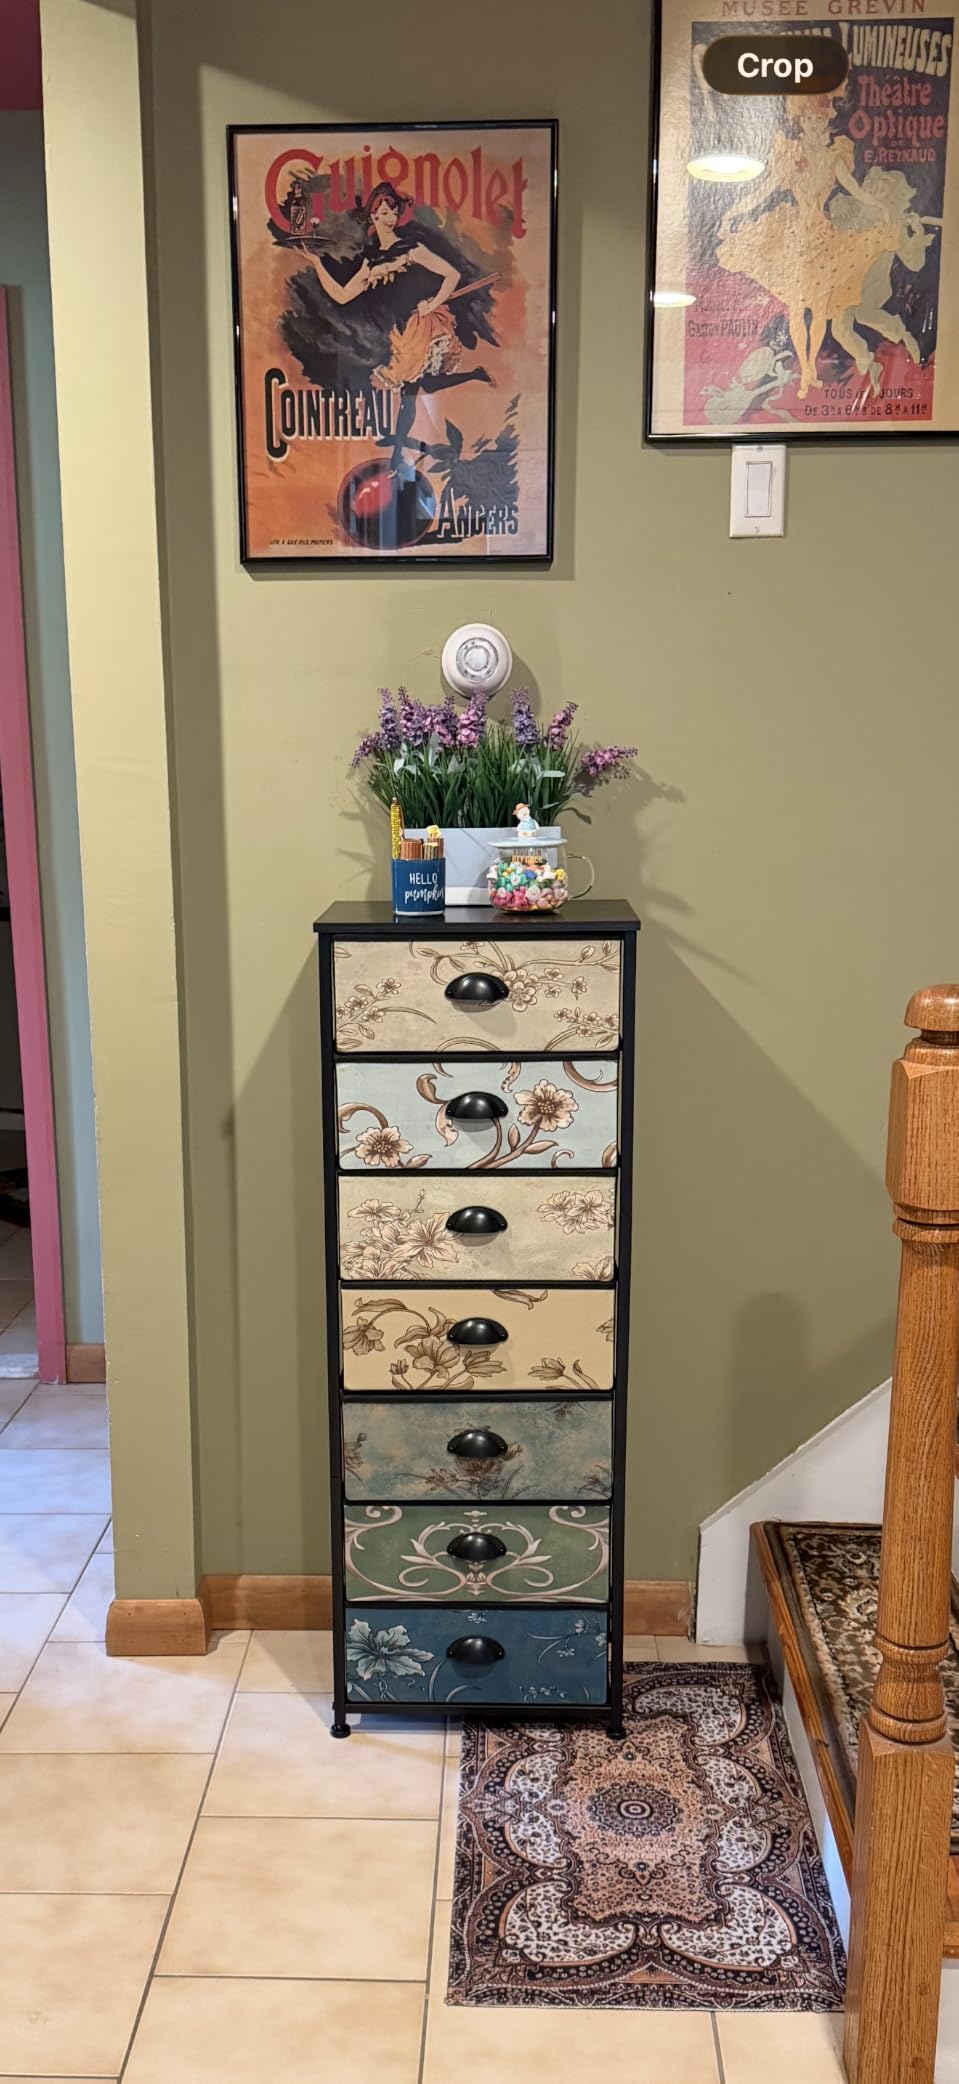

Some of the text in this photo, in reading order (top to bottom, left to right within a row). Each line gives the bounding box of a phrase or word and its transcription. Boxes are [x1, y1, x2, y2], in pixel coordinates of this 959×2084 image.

[838, 21, 953, 77] LUMINEUSES
[847, 110, 945, 148] Optique
[264, 144, 529, 239] Guignolet
[264, 367, 395, 463] COINTREAU
[824, 388, 853, 400] TOUS
[880, 387, 914, 399] JOURS
[409, 872, 438, 885] HELLO
